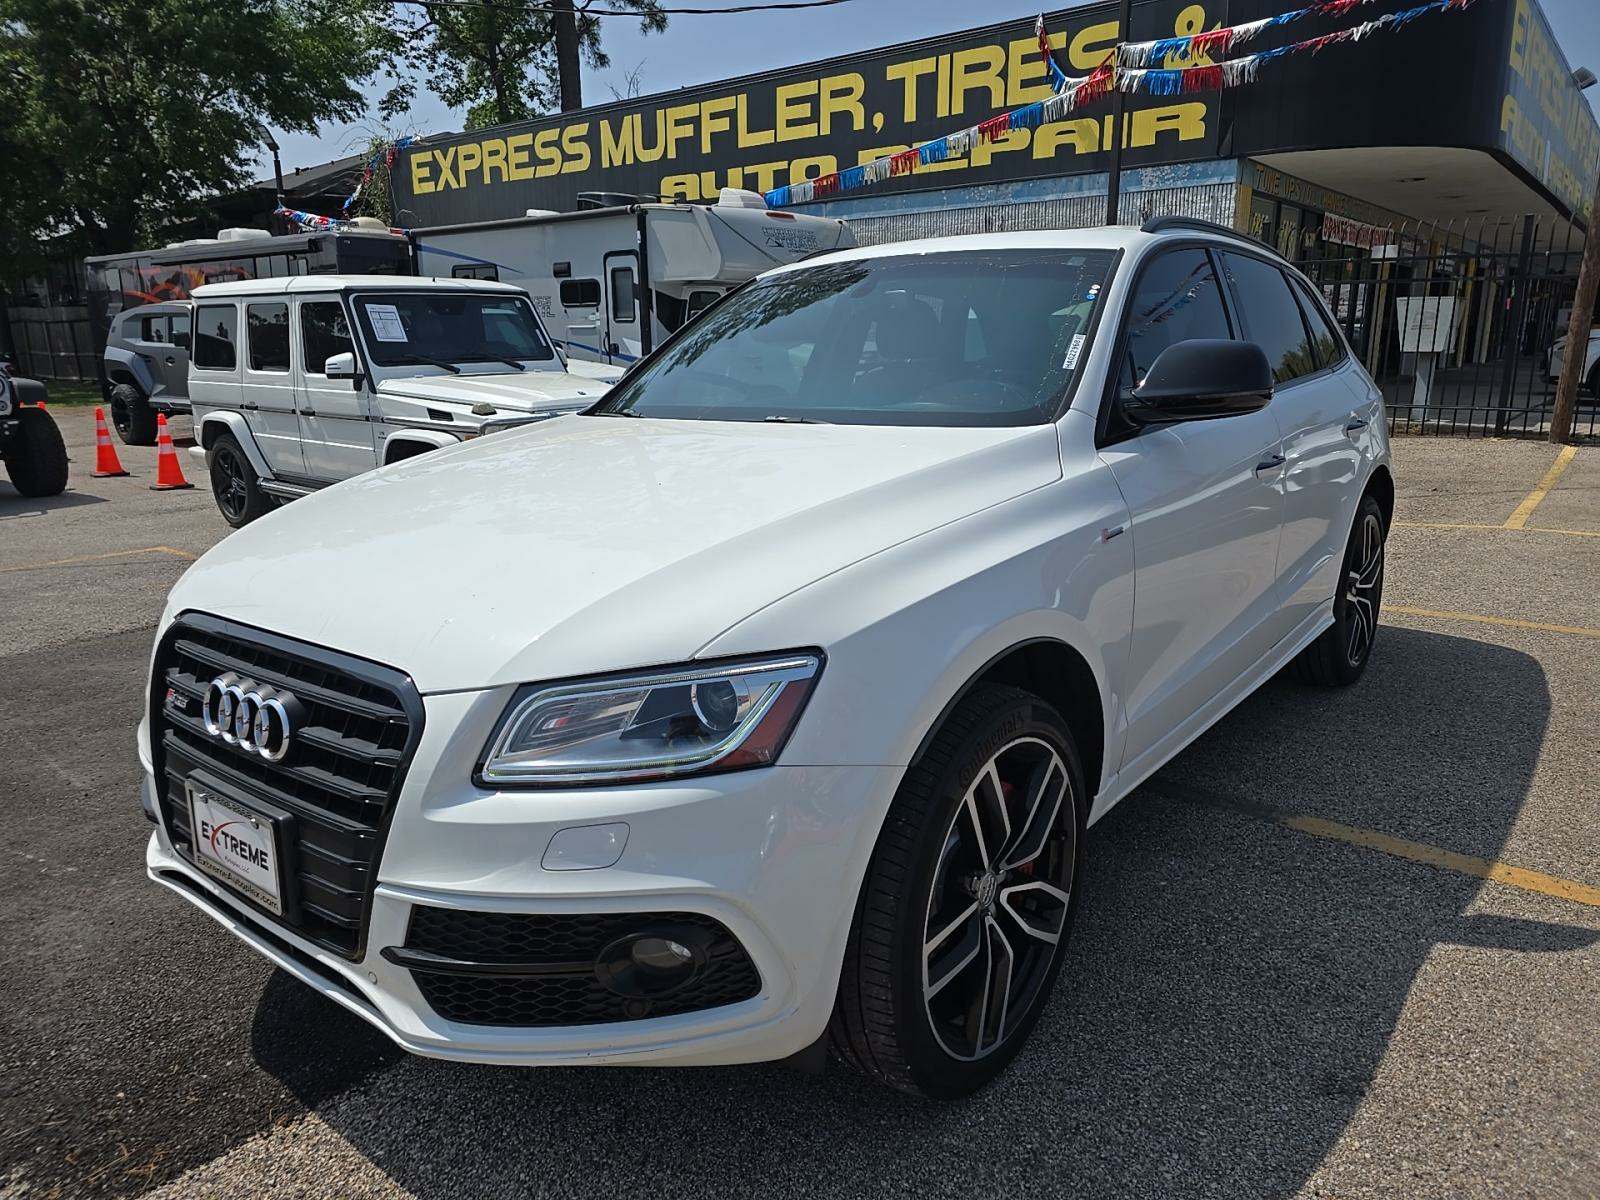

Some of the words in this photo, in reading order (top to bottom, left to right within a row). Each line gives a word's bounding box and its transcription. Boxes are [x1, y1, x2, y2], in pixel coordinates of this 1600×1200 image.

[411, 123, 592, 195] EXPRESS
[600, 73, 884, 169] MUFFLER,
[886, 21, 1120, 123] TIRES
[661, 154, 838, 203] AUTO
[201, 820, 270, 871] EXTREME
